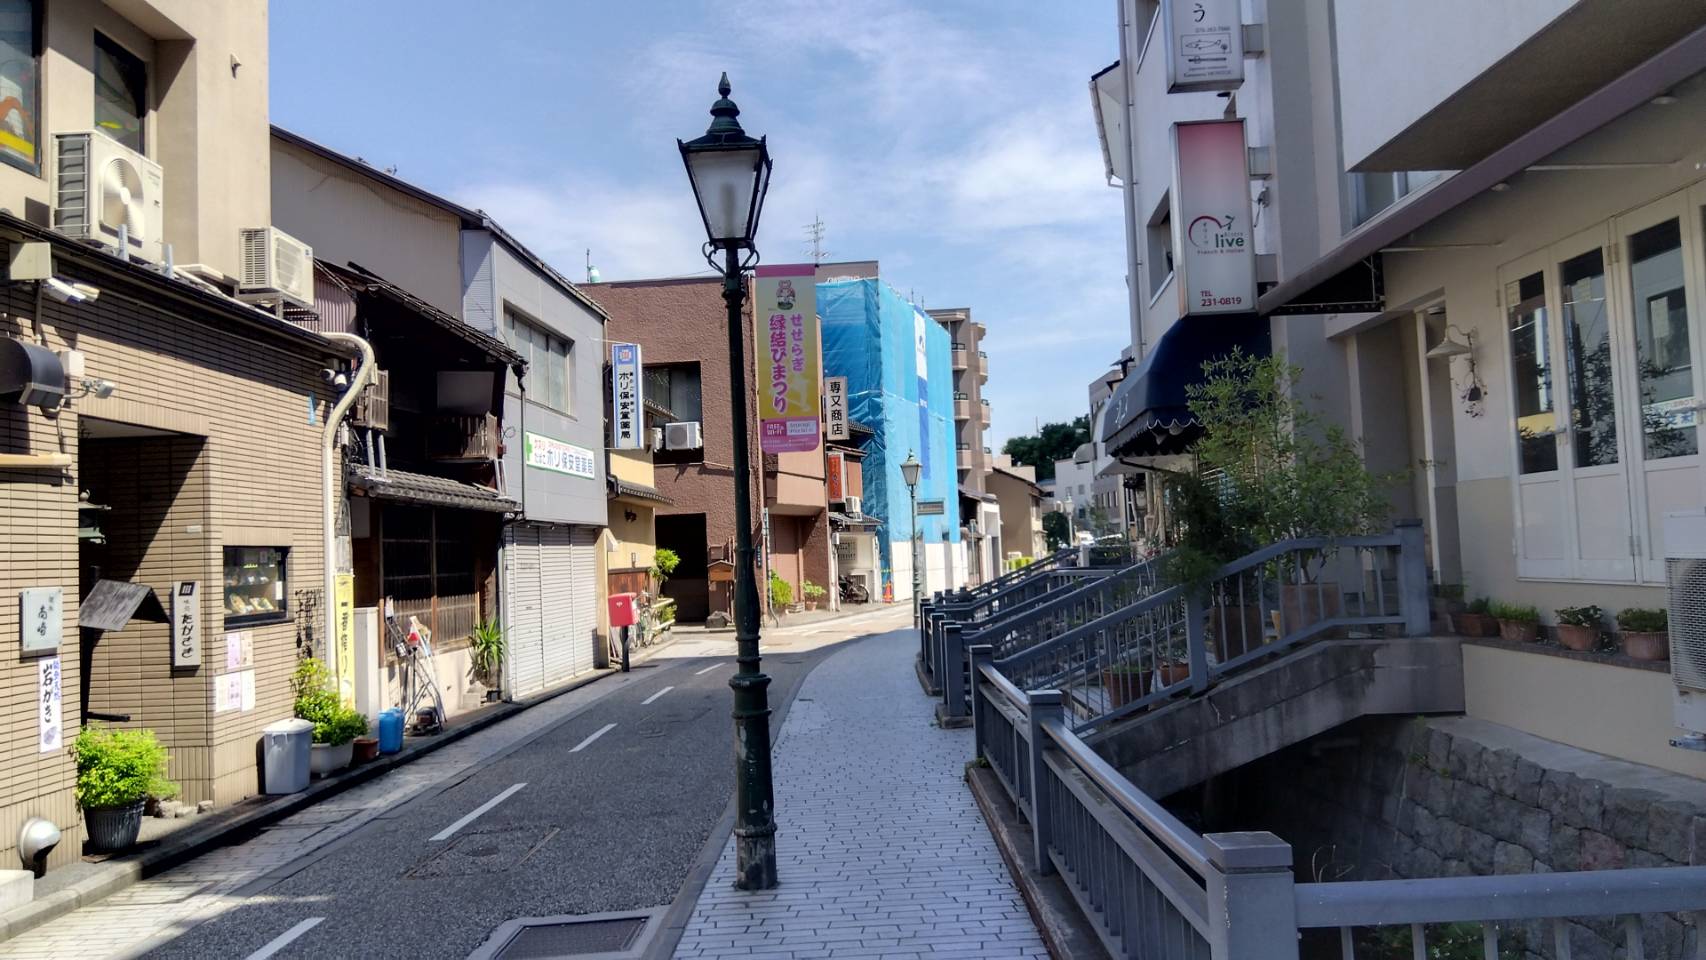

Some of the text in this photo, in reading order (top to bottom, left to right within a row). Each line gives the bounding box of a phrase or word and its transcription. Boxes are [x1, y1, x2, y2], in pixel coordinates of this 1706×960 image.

[1201, 297, 1242, 307] 231-0819
[769, 314, 788, 413] 縁結びまつり
[790, 314, 804, 372] せせらぎ
[830, 381, 843, 435] 専又商店
